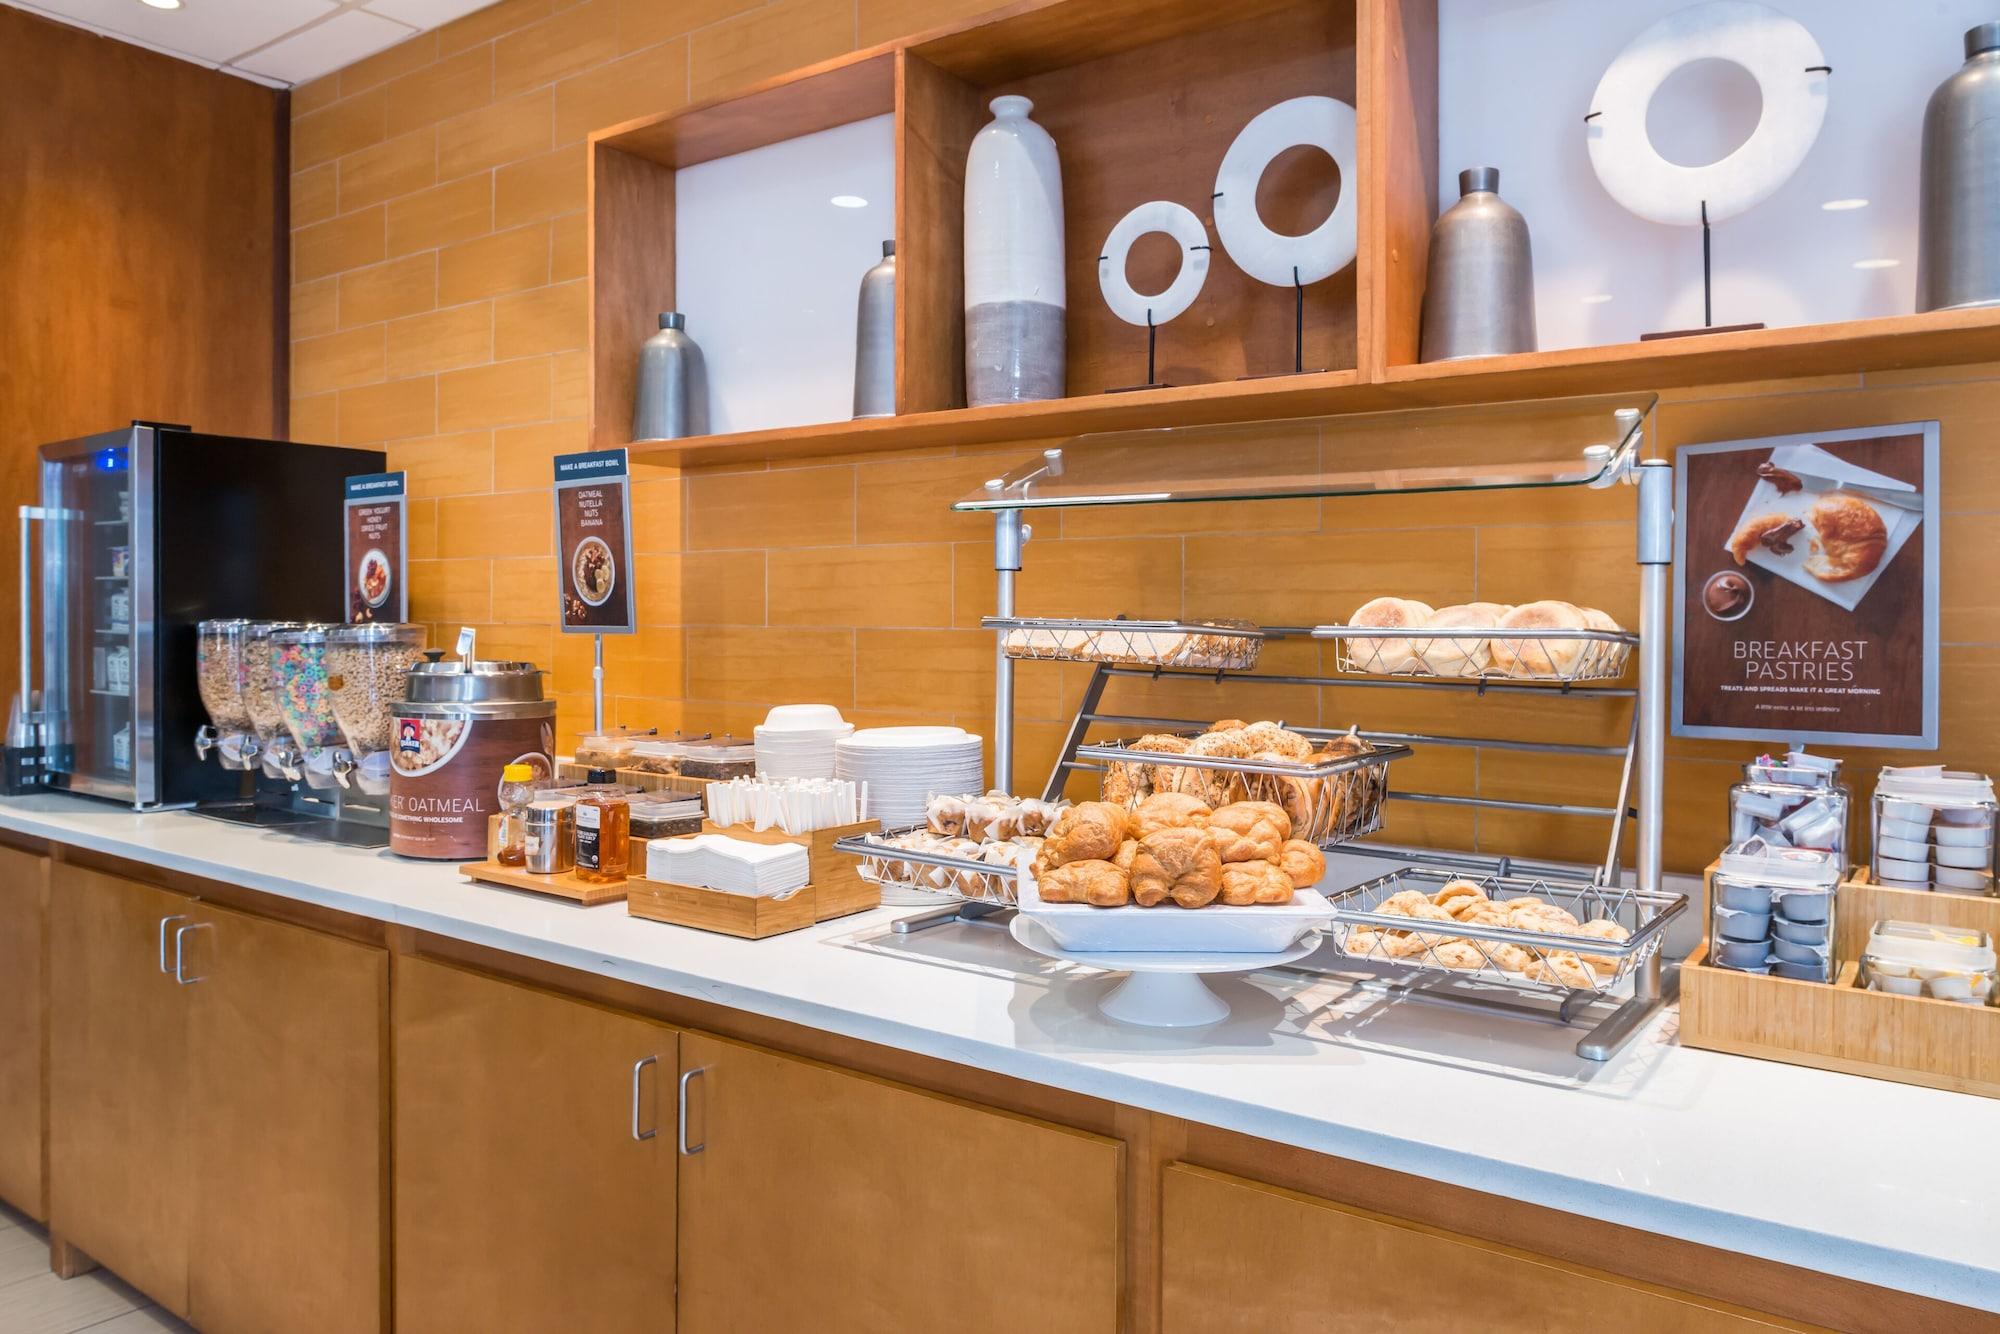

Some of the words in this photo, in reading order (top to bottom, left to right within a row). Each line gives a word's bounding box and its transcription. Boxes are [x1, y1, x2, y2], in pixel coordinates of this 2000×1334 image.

[560, 463, 573, 471] MAKE
[578, 460, 604, 469] BREAKFAST
[605, 459, 619, 467] BOWL
[578, 490, 603, 499] OATMEAL
[578, 499, 603, 508] NUTELLA
[584, 509, 599, 517] NUTS
[580, 518, 603, 527] BANANA
[368, 531, 381, 540] NUTS
[1733, 640, 1868, 660] BREAKFAST
[1745, 661, 1854, 682] PASTRIES
[1847, 687, 1881, 695] MORNING
[408, 796, 486, 813] OATMEAL
[423, 816, 464, 824] WHOLESOME
